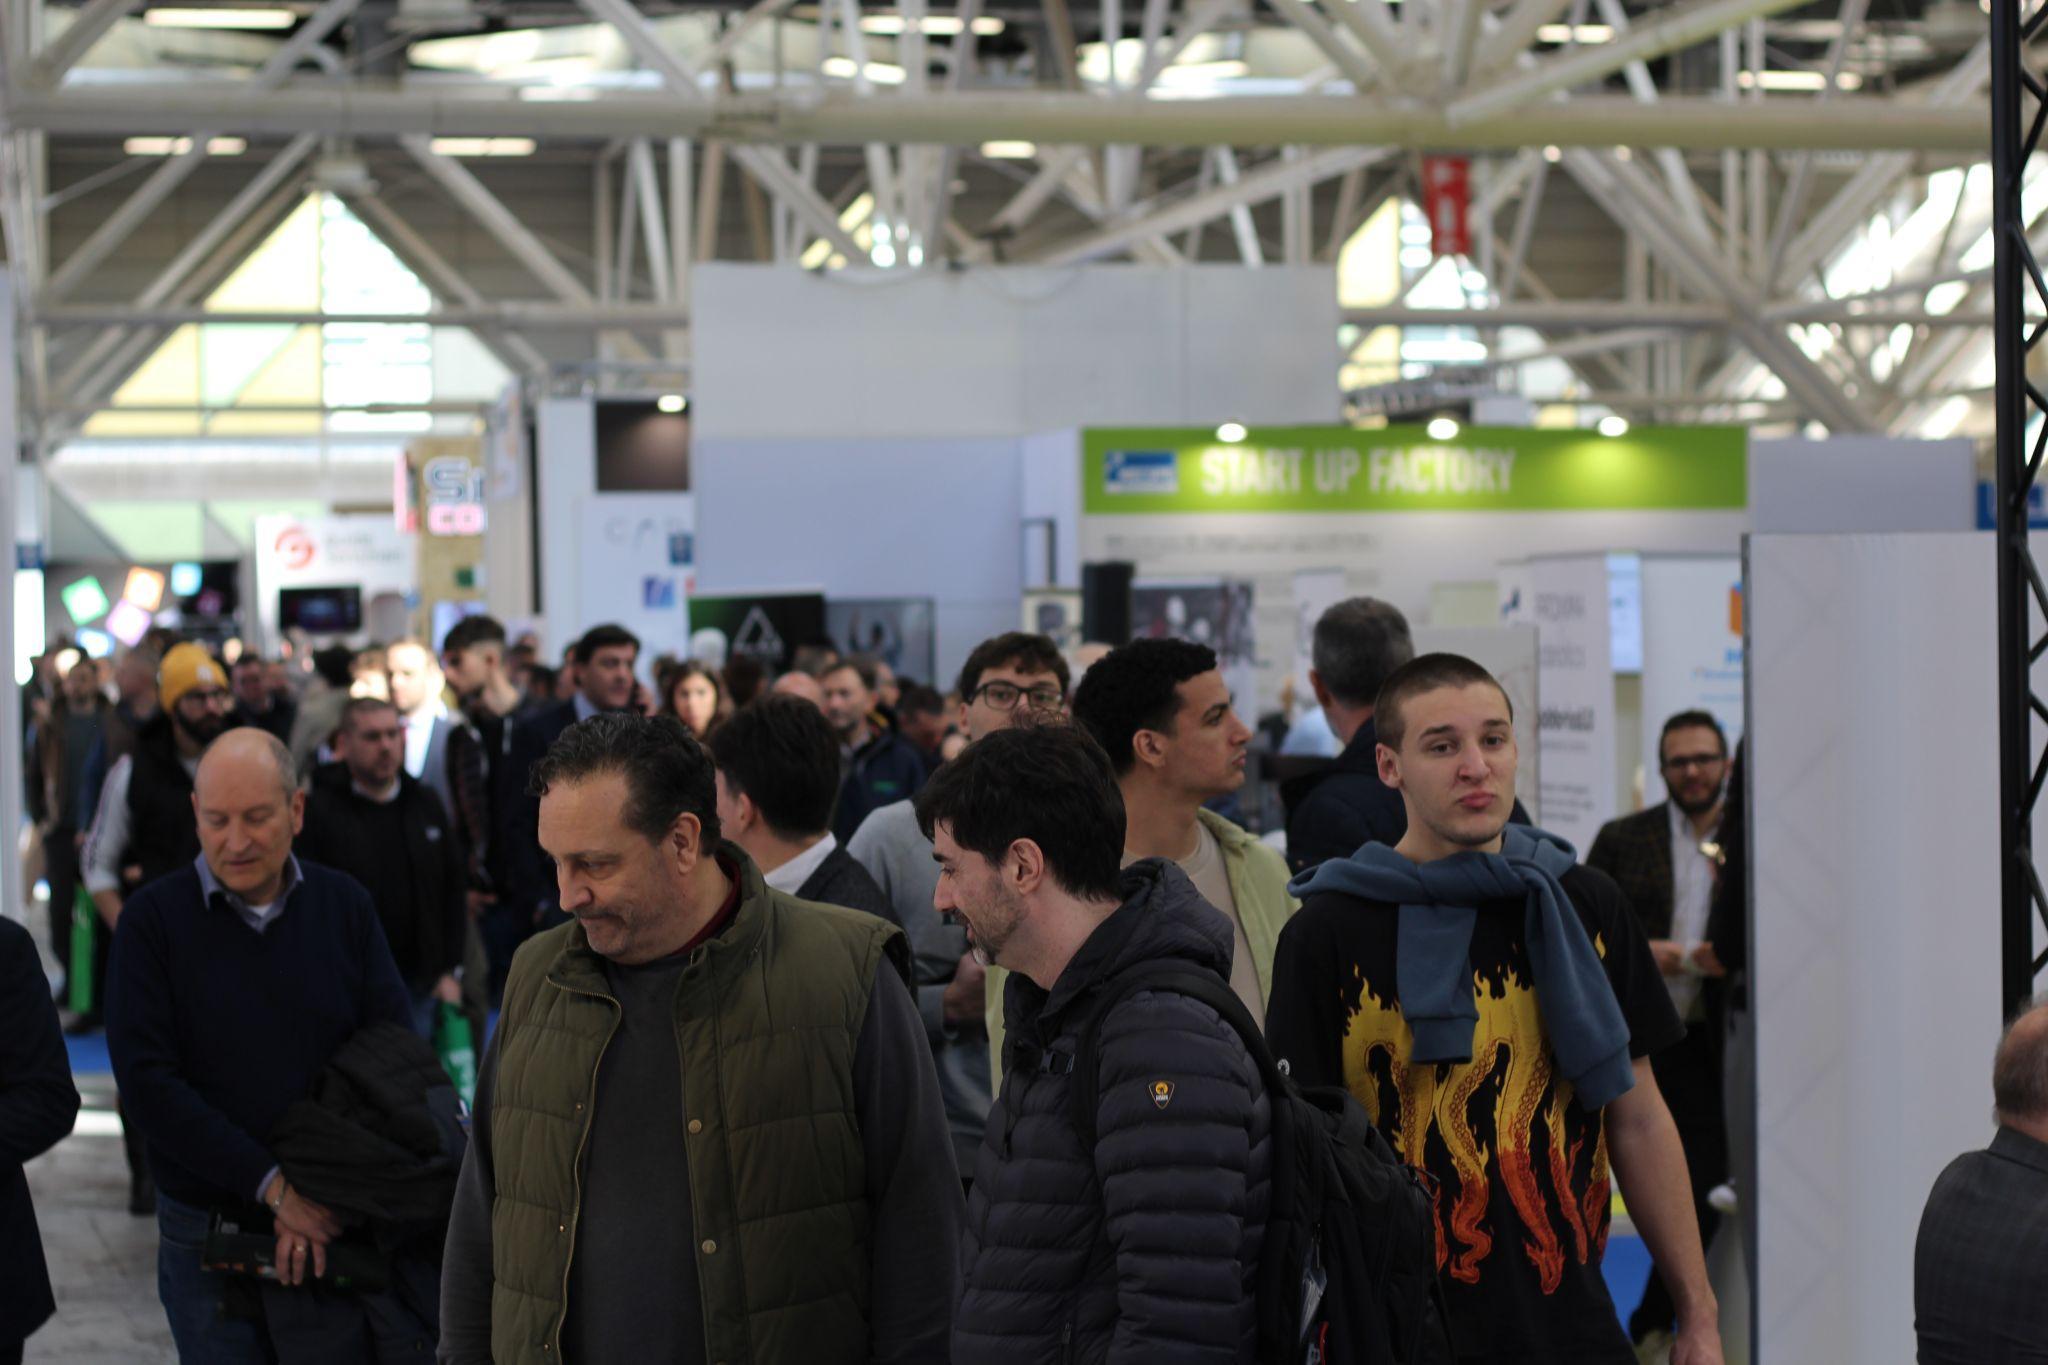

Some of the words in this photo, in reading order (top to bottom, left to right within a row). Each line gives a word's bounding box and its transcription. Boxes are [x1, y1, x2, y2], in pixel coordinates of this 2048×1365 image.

[1200, 446, 1304, 494] START
[1312, 447, 1361, 494] UP
[1367, 446, 1515, 494] FACTORY
